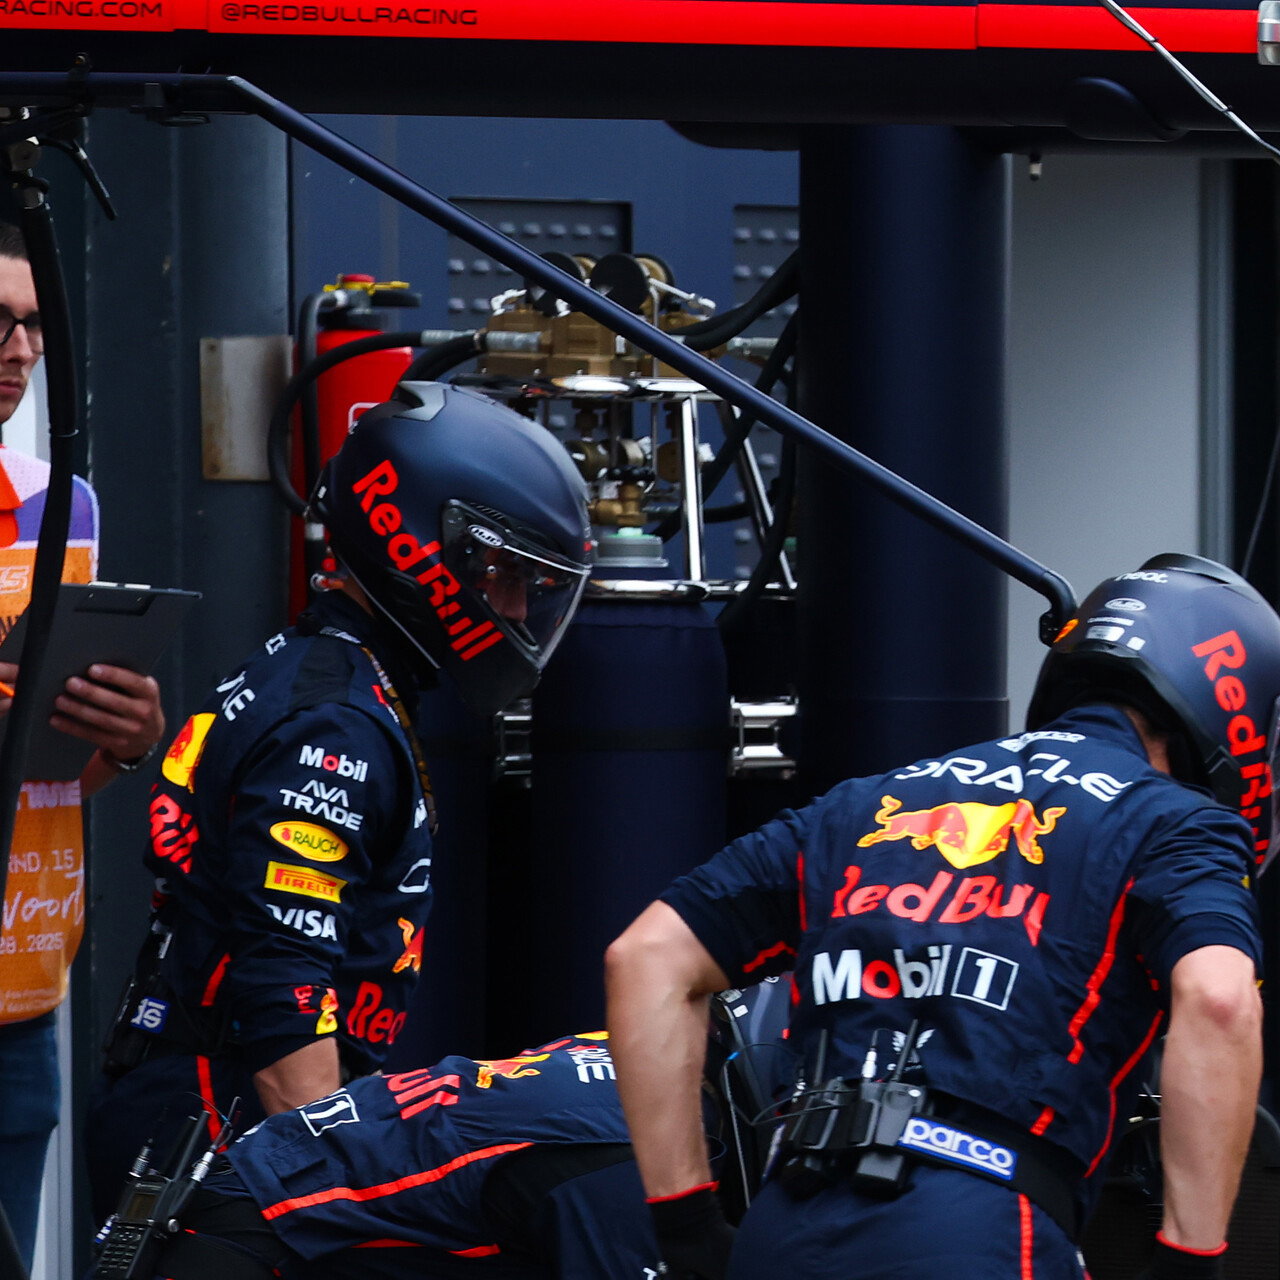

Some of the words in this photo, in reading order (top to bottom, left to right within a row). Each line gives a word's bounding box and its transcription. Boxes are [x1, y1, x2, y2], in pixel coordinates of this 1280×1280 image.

[0, 0, 162, 18] ACING.COM
[221, 4, 478, 25] @REDBULLRACING
[352, 459, 442, 572] Red
[1191, 630, 1266, 756] Red
[299, 745, 368, 783] Mobil
[279, 788, 364, 832] TRADE
[301, 779, 350, 808] AVA
[292, 830, 340, 856] RAUCH
[273, 868, 338, 898] PIRELLI
[265, 903, 338, 942] VISA
[811, 944, 952, 1006] Mobil
[382, 1067, 460, 1120] ull
[902, 1118, 1014, 1177] parco
